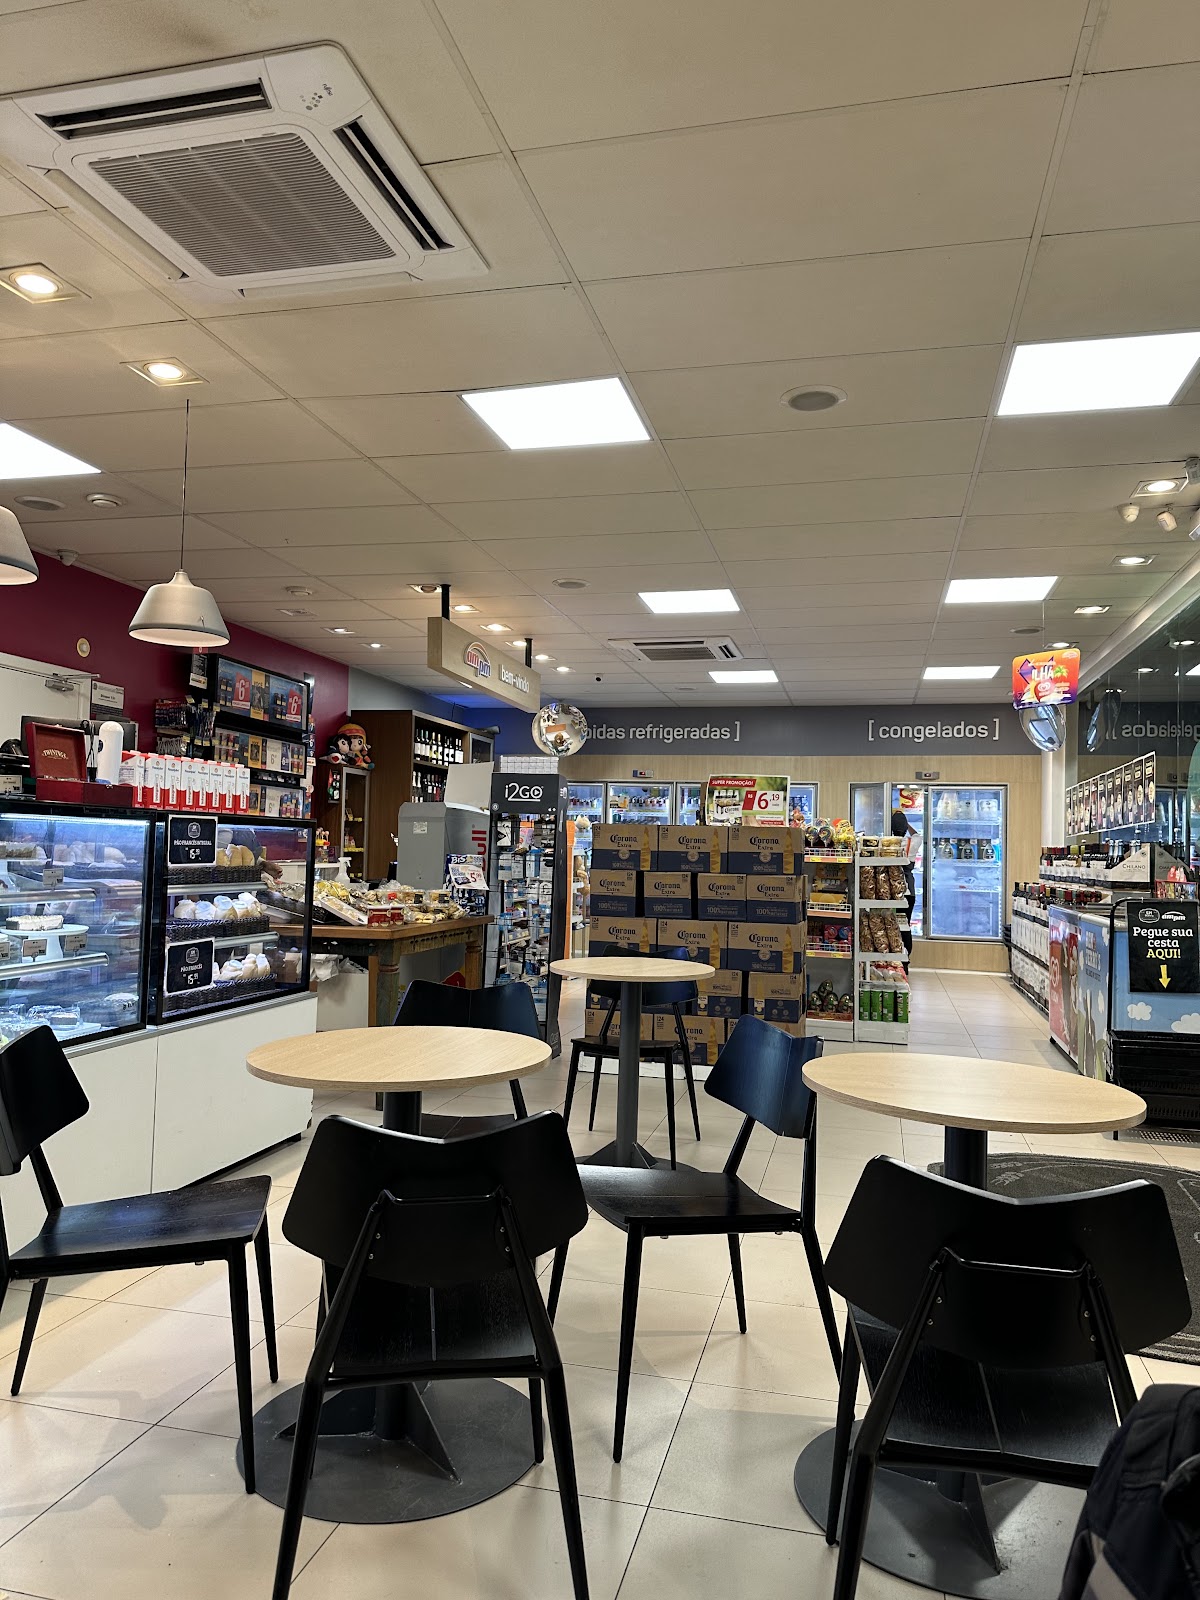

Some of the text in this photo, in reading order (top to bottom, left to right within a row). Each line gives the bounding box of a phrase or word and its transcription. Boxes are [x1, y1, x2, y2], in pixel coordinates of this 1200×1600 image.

[501, 664, 530, 693] bem-vindo
[629, 723, 730, 743] refrigeradas
[879, 721, 989, 742] congelados
[610, 834, 638, 843] Corona
[678, 836, 707, 845] Corona
[750, 836, 779, 846] Corona
[600, 879, 626, 887] Corona
[654, 881, 680, 890] Corona
[708, 883, 735, 891] Corona
[757, 884, 785, 893] Corona
[608, 926, 636, 935] Corona
[678, 930, 706, 940] Corona
[1133, 927, 1193, 939] Pegue sua
[749, 933, 778, 943] Corona
[1148, 939, 1179, 947] cesta
[1146, 949, 1181, 960] AQUI!
